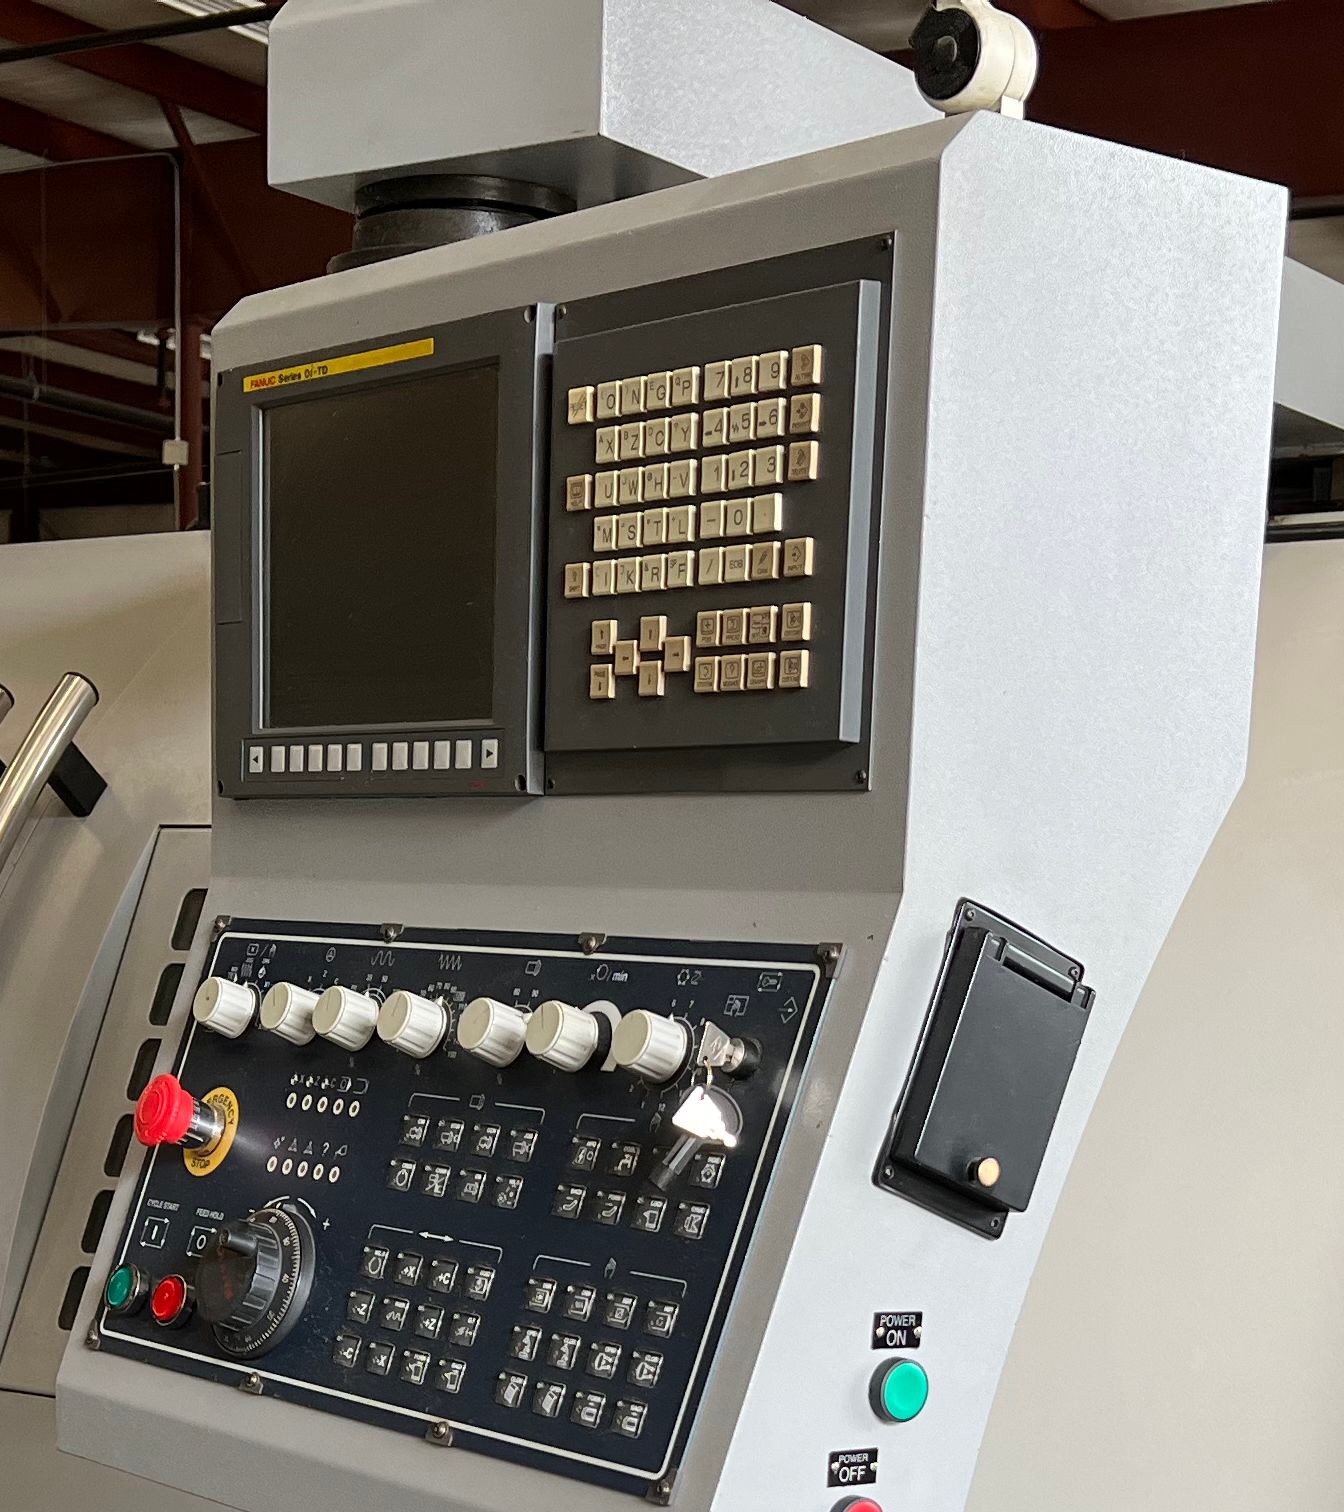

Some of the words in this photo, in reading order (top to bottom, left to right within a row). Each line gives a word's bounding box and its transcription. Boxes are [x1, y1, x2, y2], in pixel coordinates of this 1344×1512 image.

[742, 366, 752, 384] 8
[770, 361, 780, 379] 9
[250, 376, 276, 389] FANUC
[278, 371, 301, 384] Series
[715, 370, 725, 388] 7
[656, 385, 666, 401] G
[682, 380, 691, 396] P
[631, 389, 640, 405] N
[741, 412, 751, 431] 5
[768, 408, 778, 425] 6
[681, 426, 690, 442] Y
[713, 418, 723, 434] 4
[606, 438, 615, 455] X
[630, 434, 639, 451] Z
[655, 430, 665, 447] C
[739, 460, 749, 478] 2
[766, 456, 776, 473] 3
[679, 472, 690, 488] V
[713, 465, 720, 481] 1
[604, 483, 613, 499] U
[627, 480, 639, 497] W
[654, 476, 663, 493] H
[627, 524, 636, 540] S
[653, 520, 662, 536] T
[678, 519, 686, 535] L
[602, 527, 612, 544] M
[191, 1156, 210, 1169] STOP
[147, 1199, 164, 1209] CYCLE
[163, 1202, 180, 1211] START
[196, 1208, 210, 1218] FEED
[209, 1210, 225, 1221] HOLD
[879, 1314, 916, 1327] POWER
[886, 1329, 907, 1346] ON
[838, 1452, 869, 1464] POWER
[838, 1465, 867, 1482] OFF
